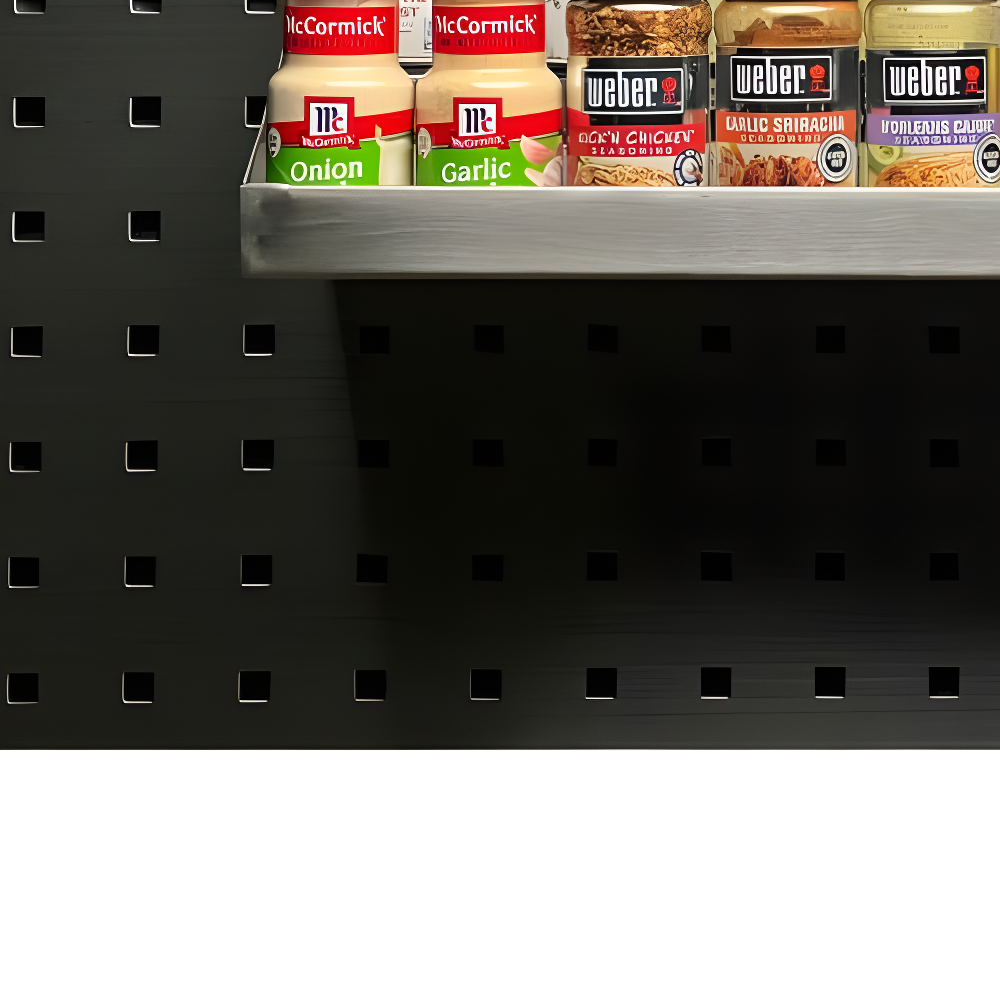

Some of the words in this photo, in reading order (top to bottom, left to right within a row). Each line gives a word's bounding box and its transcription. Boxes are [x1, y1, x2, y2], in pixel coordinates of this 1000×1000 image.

[587, 71, 658, 108] weber
[736, 58, 806, 95] weber
[889, 59, 962, 97] weber
[290, 158, 363, 182] Onion
[441, 157, 511, 184] Garlic
